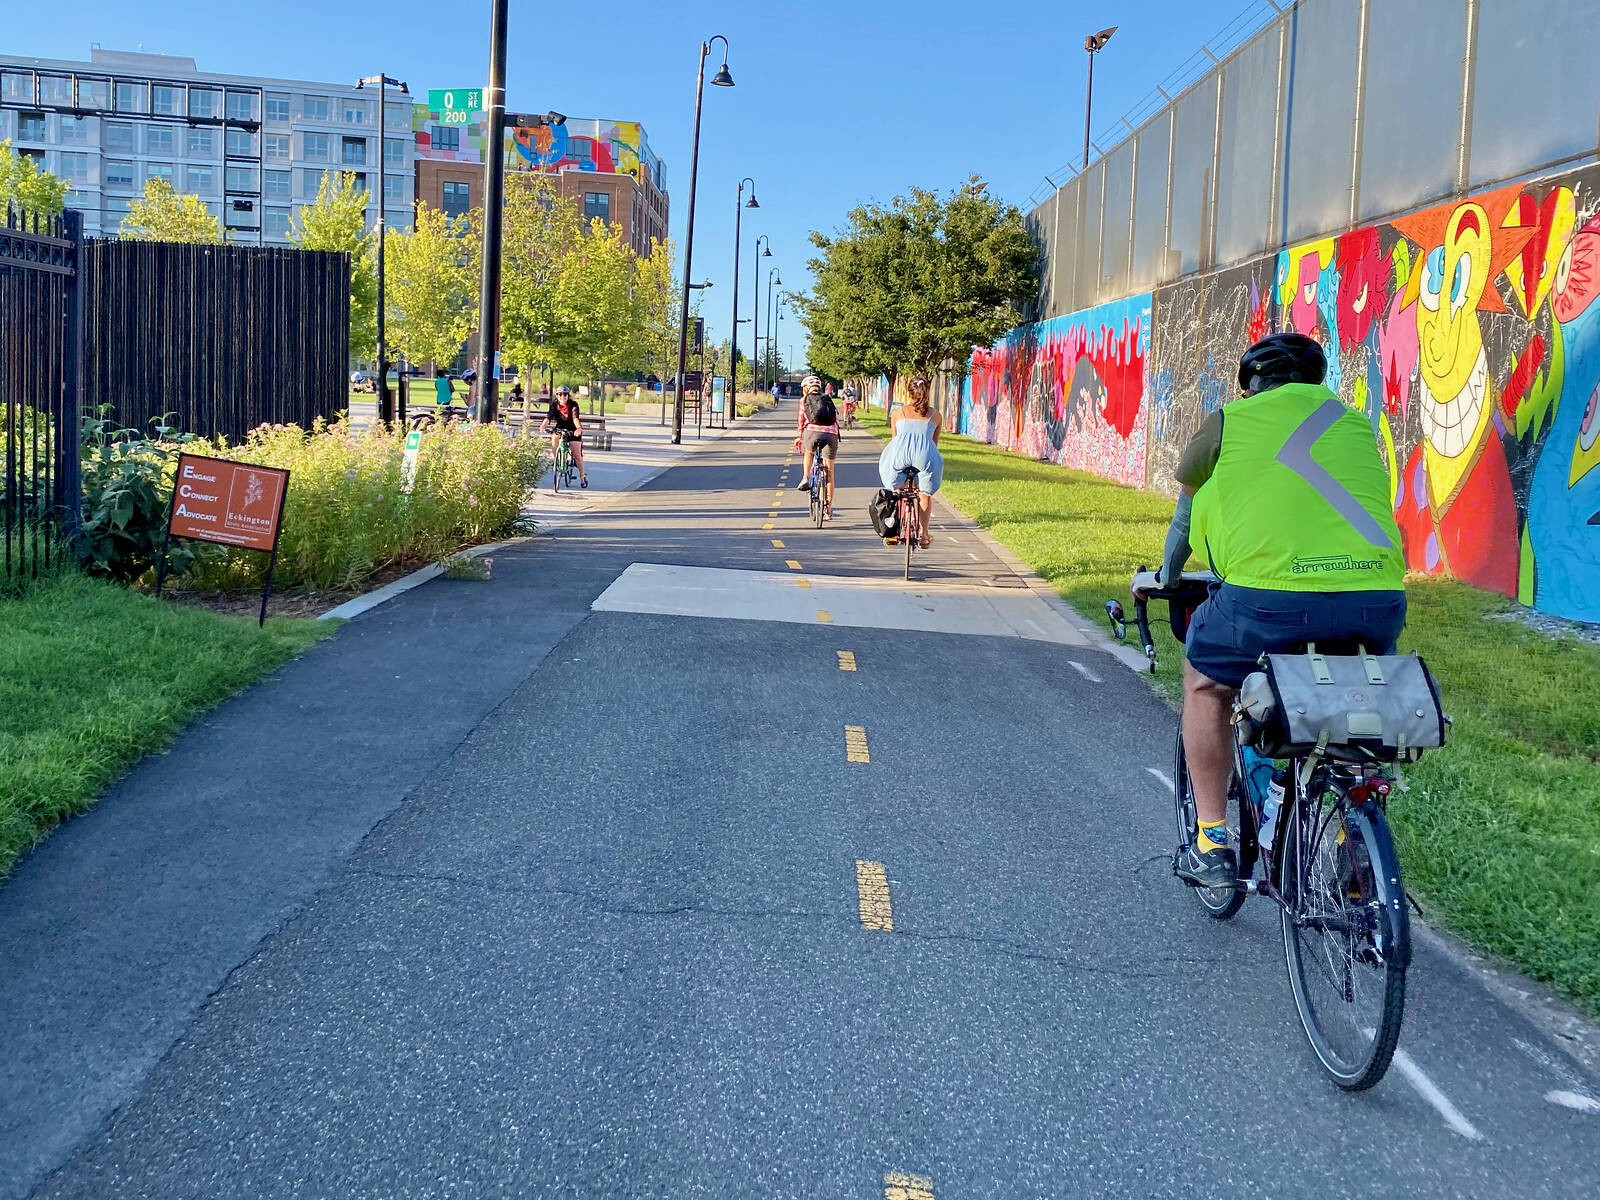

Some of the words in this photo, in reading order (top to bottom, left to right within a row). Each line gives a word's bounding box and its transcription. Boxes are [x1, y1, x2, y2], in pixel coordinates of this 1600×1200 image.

[444, 92, 454, 109] Q
[467, 91, 478, 100] ST
[467, 100, 479, 108] NE
[445, 111, 467, 123] 200
[228, 512, 270, 526] Eckington
